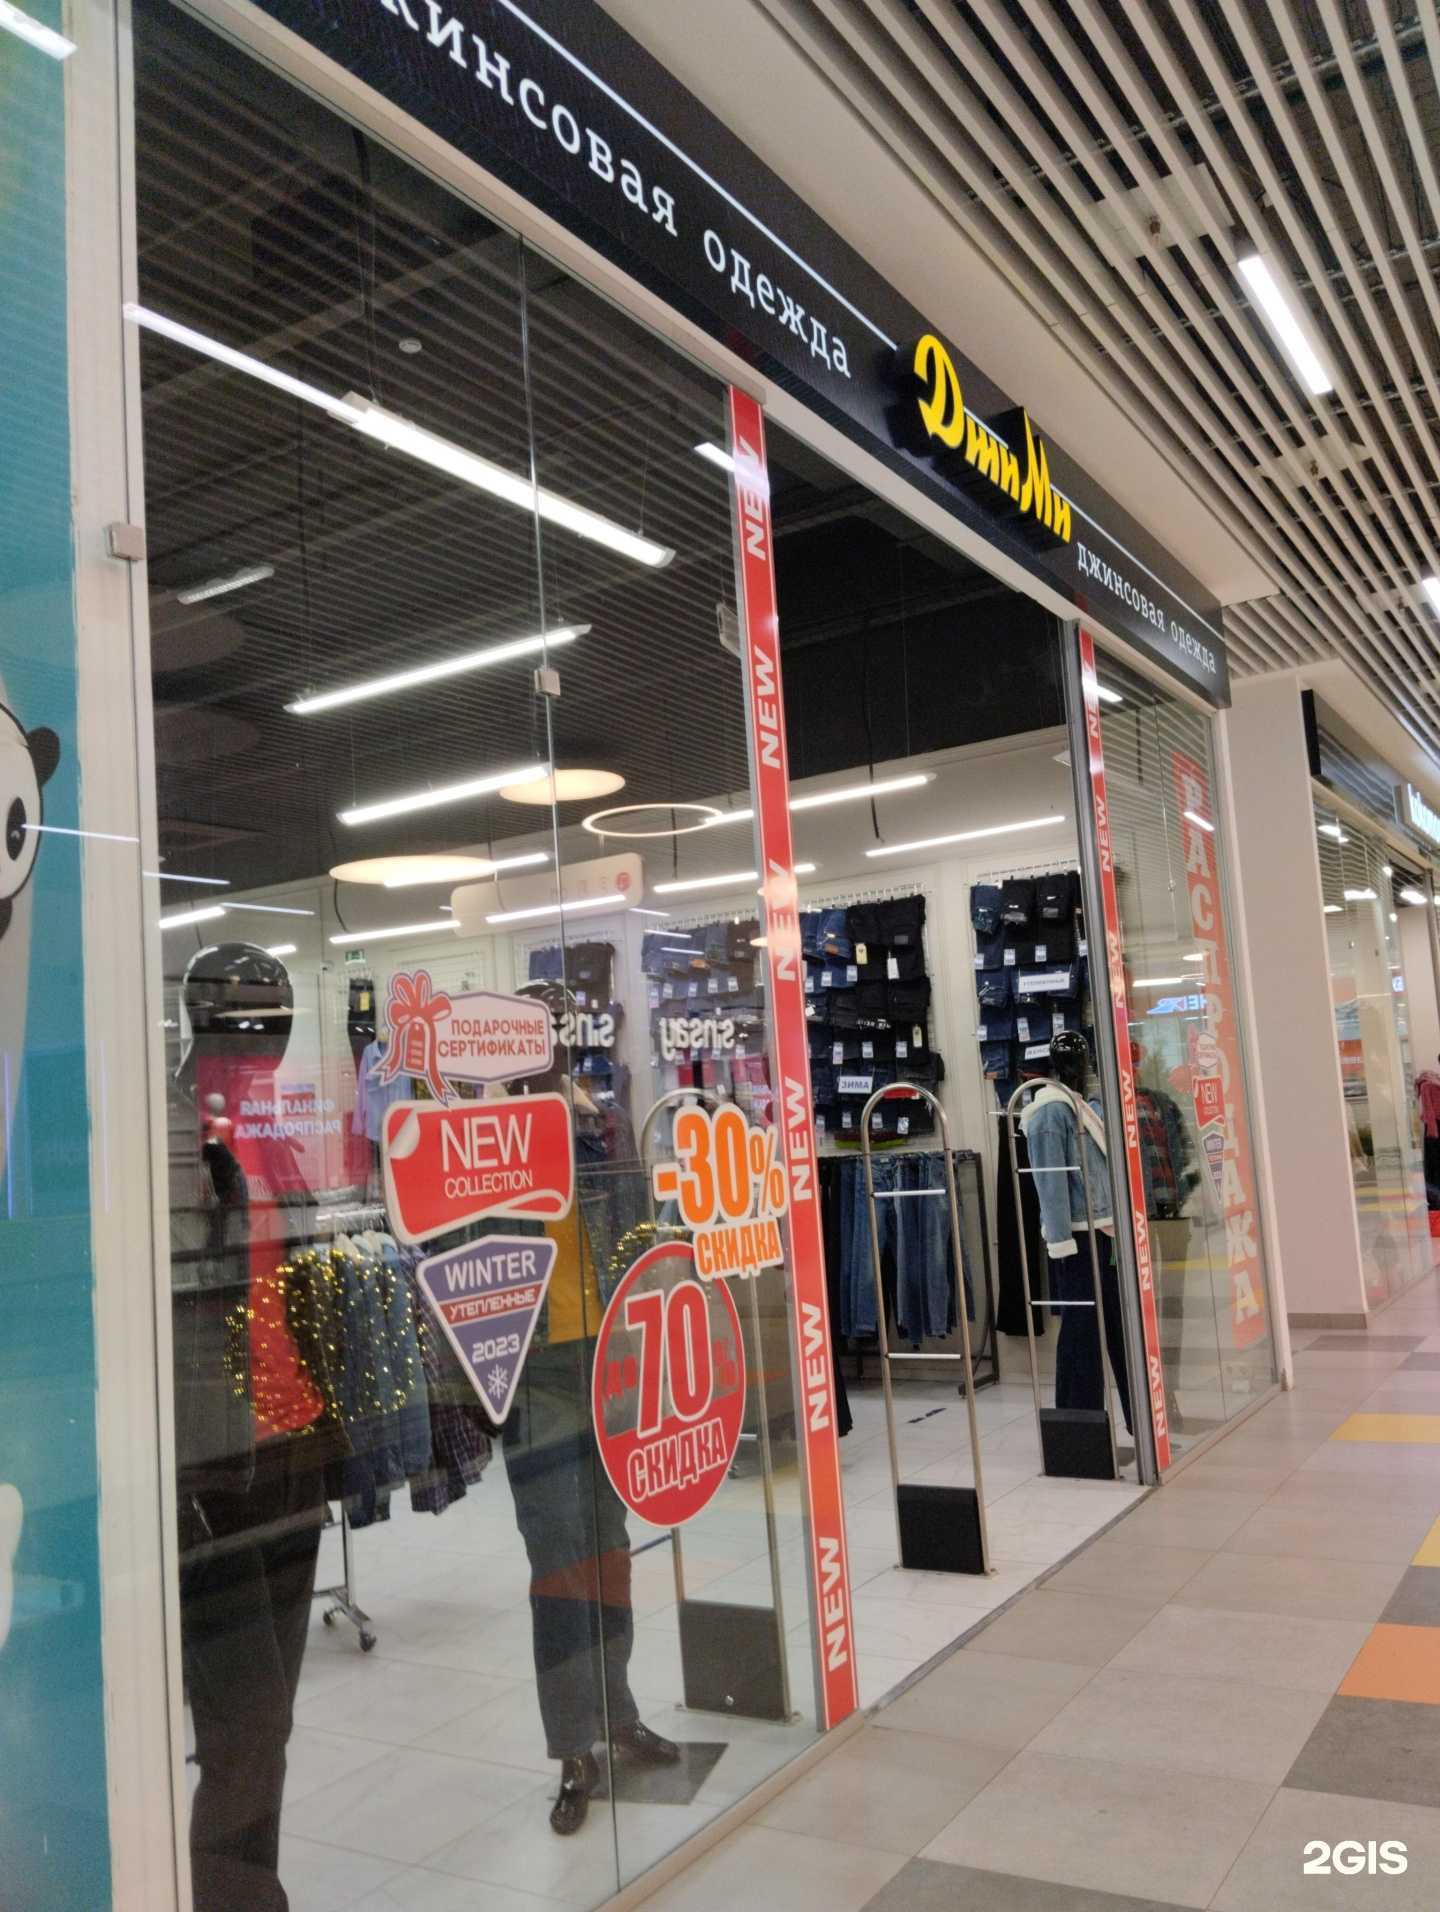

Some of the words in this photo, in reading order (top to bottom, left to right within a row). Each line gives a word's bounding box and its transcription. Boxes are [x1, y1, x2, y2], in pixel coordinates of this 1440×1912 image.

[703, 229, 852, 379] одежда
[1077, 541, 1166, 633] джинсовая
[1170, 620, 1217, 675] одежда
[752, 645, 782, 770] NEW
[1095, 796, 1112, 872] NEW
[768, 858, 797, 982] NEW
[1105, 930, 1125, 1009] NEW
[437, 1039, 547, 1058] СЕРТИФИКАТЫ
[451, 1018, 545, 1036] ПОДАРОЧНЫЕ
[440, 1112, 532, 1173] NEW
[784, 1076, 814, 1203] NEW
[1120, 1068, 1138, 1150] NEW
[444, 1169, 534, 1200] COLLECTION
[656, 1110, 786, 1225] -30%
[444, 1249, 537, 1294] WINTER
[695, 1219, 783, 1277] СКИДКА
[1135, 1209, 1152, 1292] NEW
[449, 1287, 537, 1321] УТЕПЛЕННЫЕ
[471, 1332, 522, 1365] 2023
[801, 1301, 830, 1433] NEW
[1149, 1354, 1168, 1440] NEW
[626, 1416, 729, 1503] СКИДКА
[818, 1536, 848, 1674] NEW
